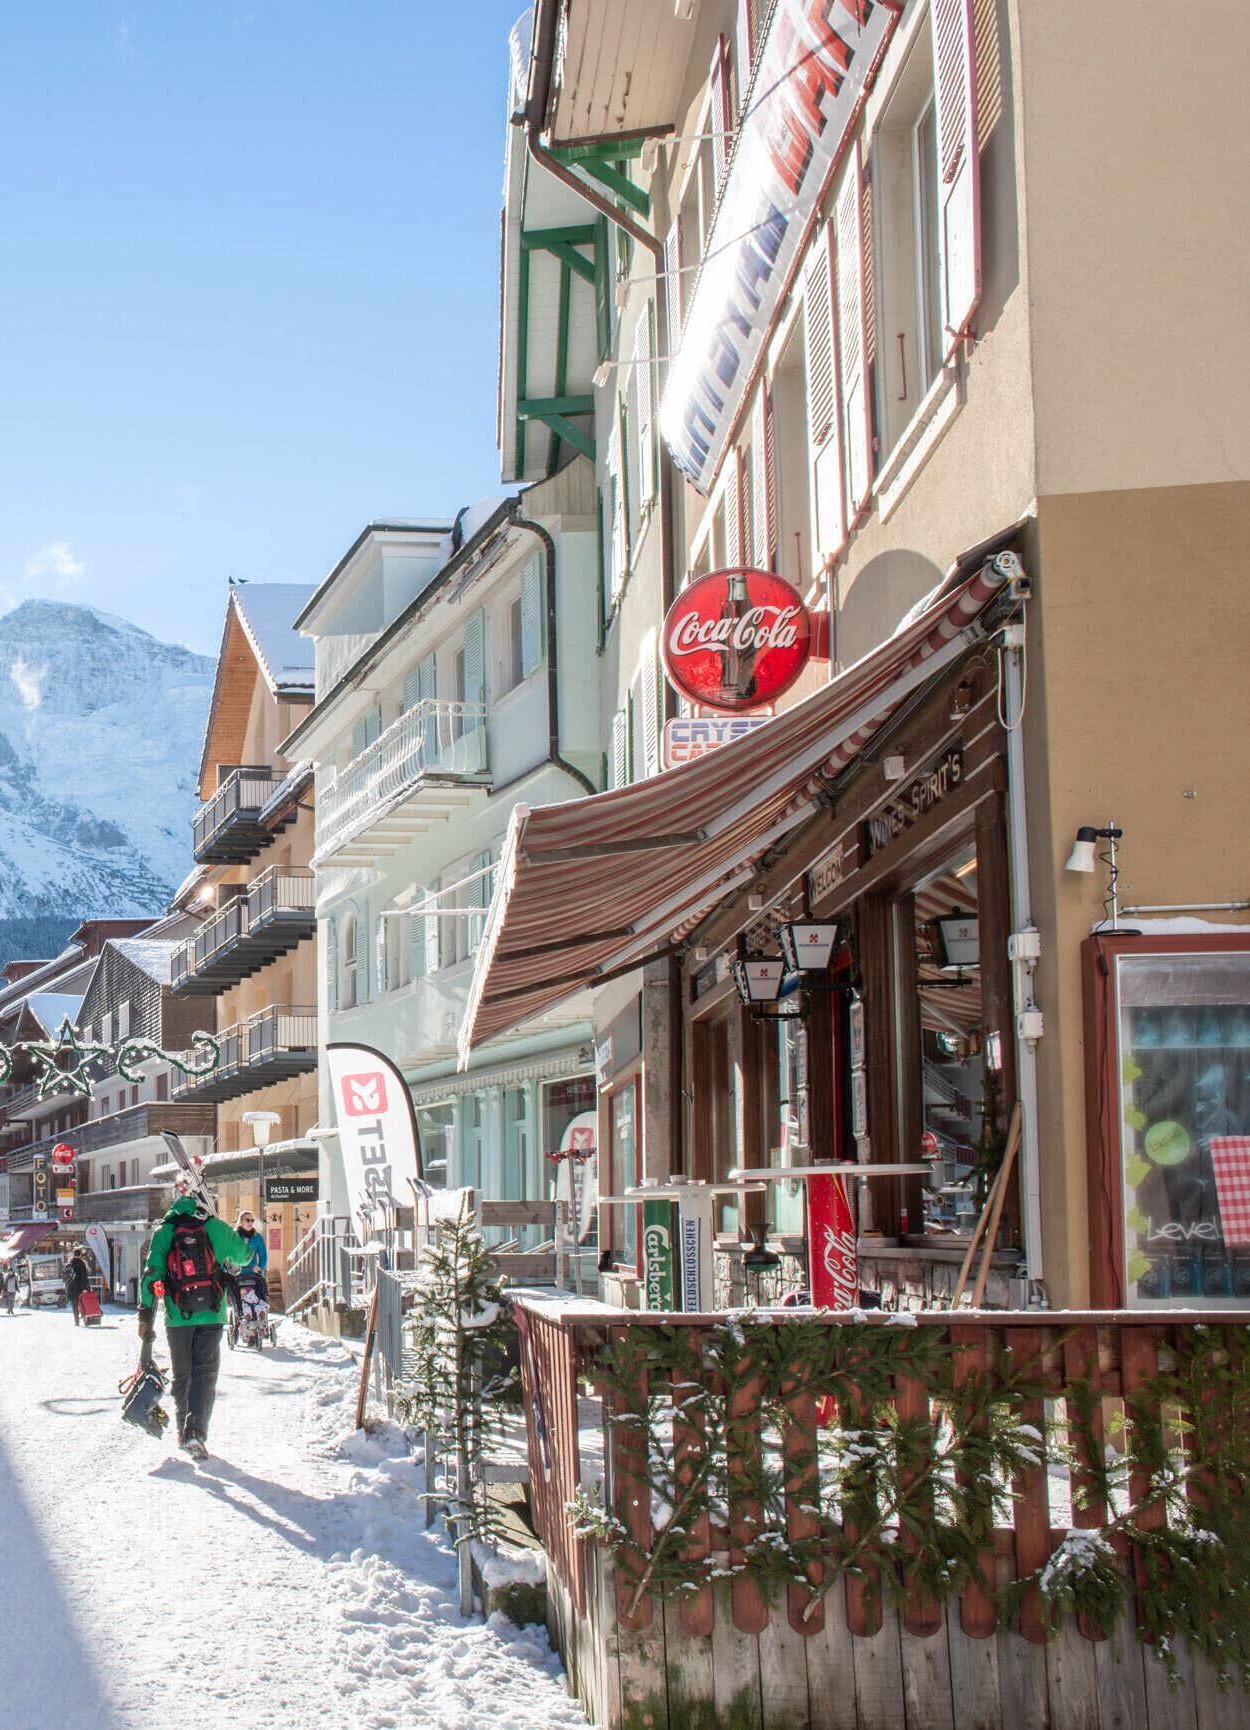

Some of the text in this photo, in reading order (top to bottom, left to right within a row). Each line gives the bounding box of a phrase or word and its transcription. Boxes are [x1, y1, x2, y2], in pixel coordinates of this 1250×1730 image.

[670, 605, 802, 656] Coca-Cola
[911, 753, 961, 816] SPIRIT'S
[36, 1158, 47, 1212] FOTO
[270, 1185, 314, 1194] PASTA & MORE
[685, 1219, 697, 1312] FELDSCHLÖSSCHEN
